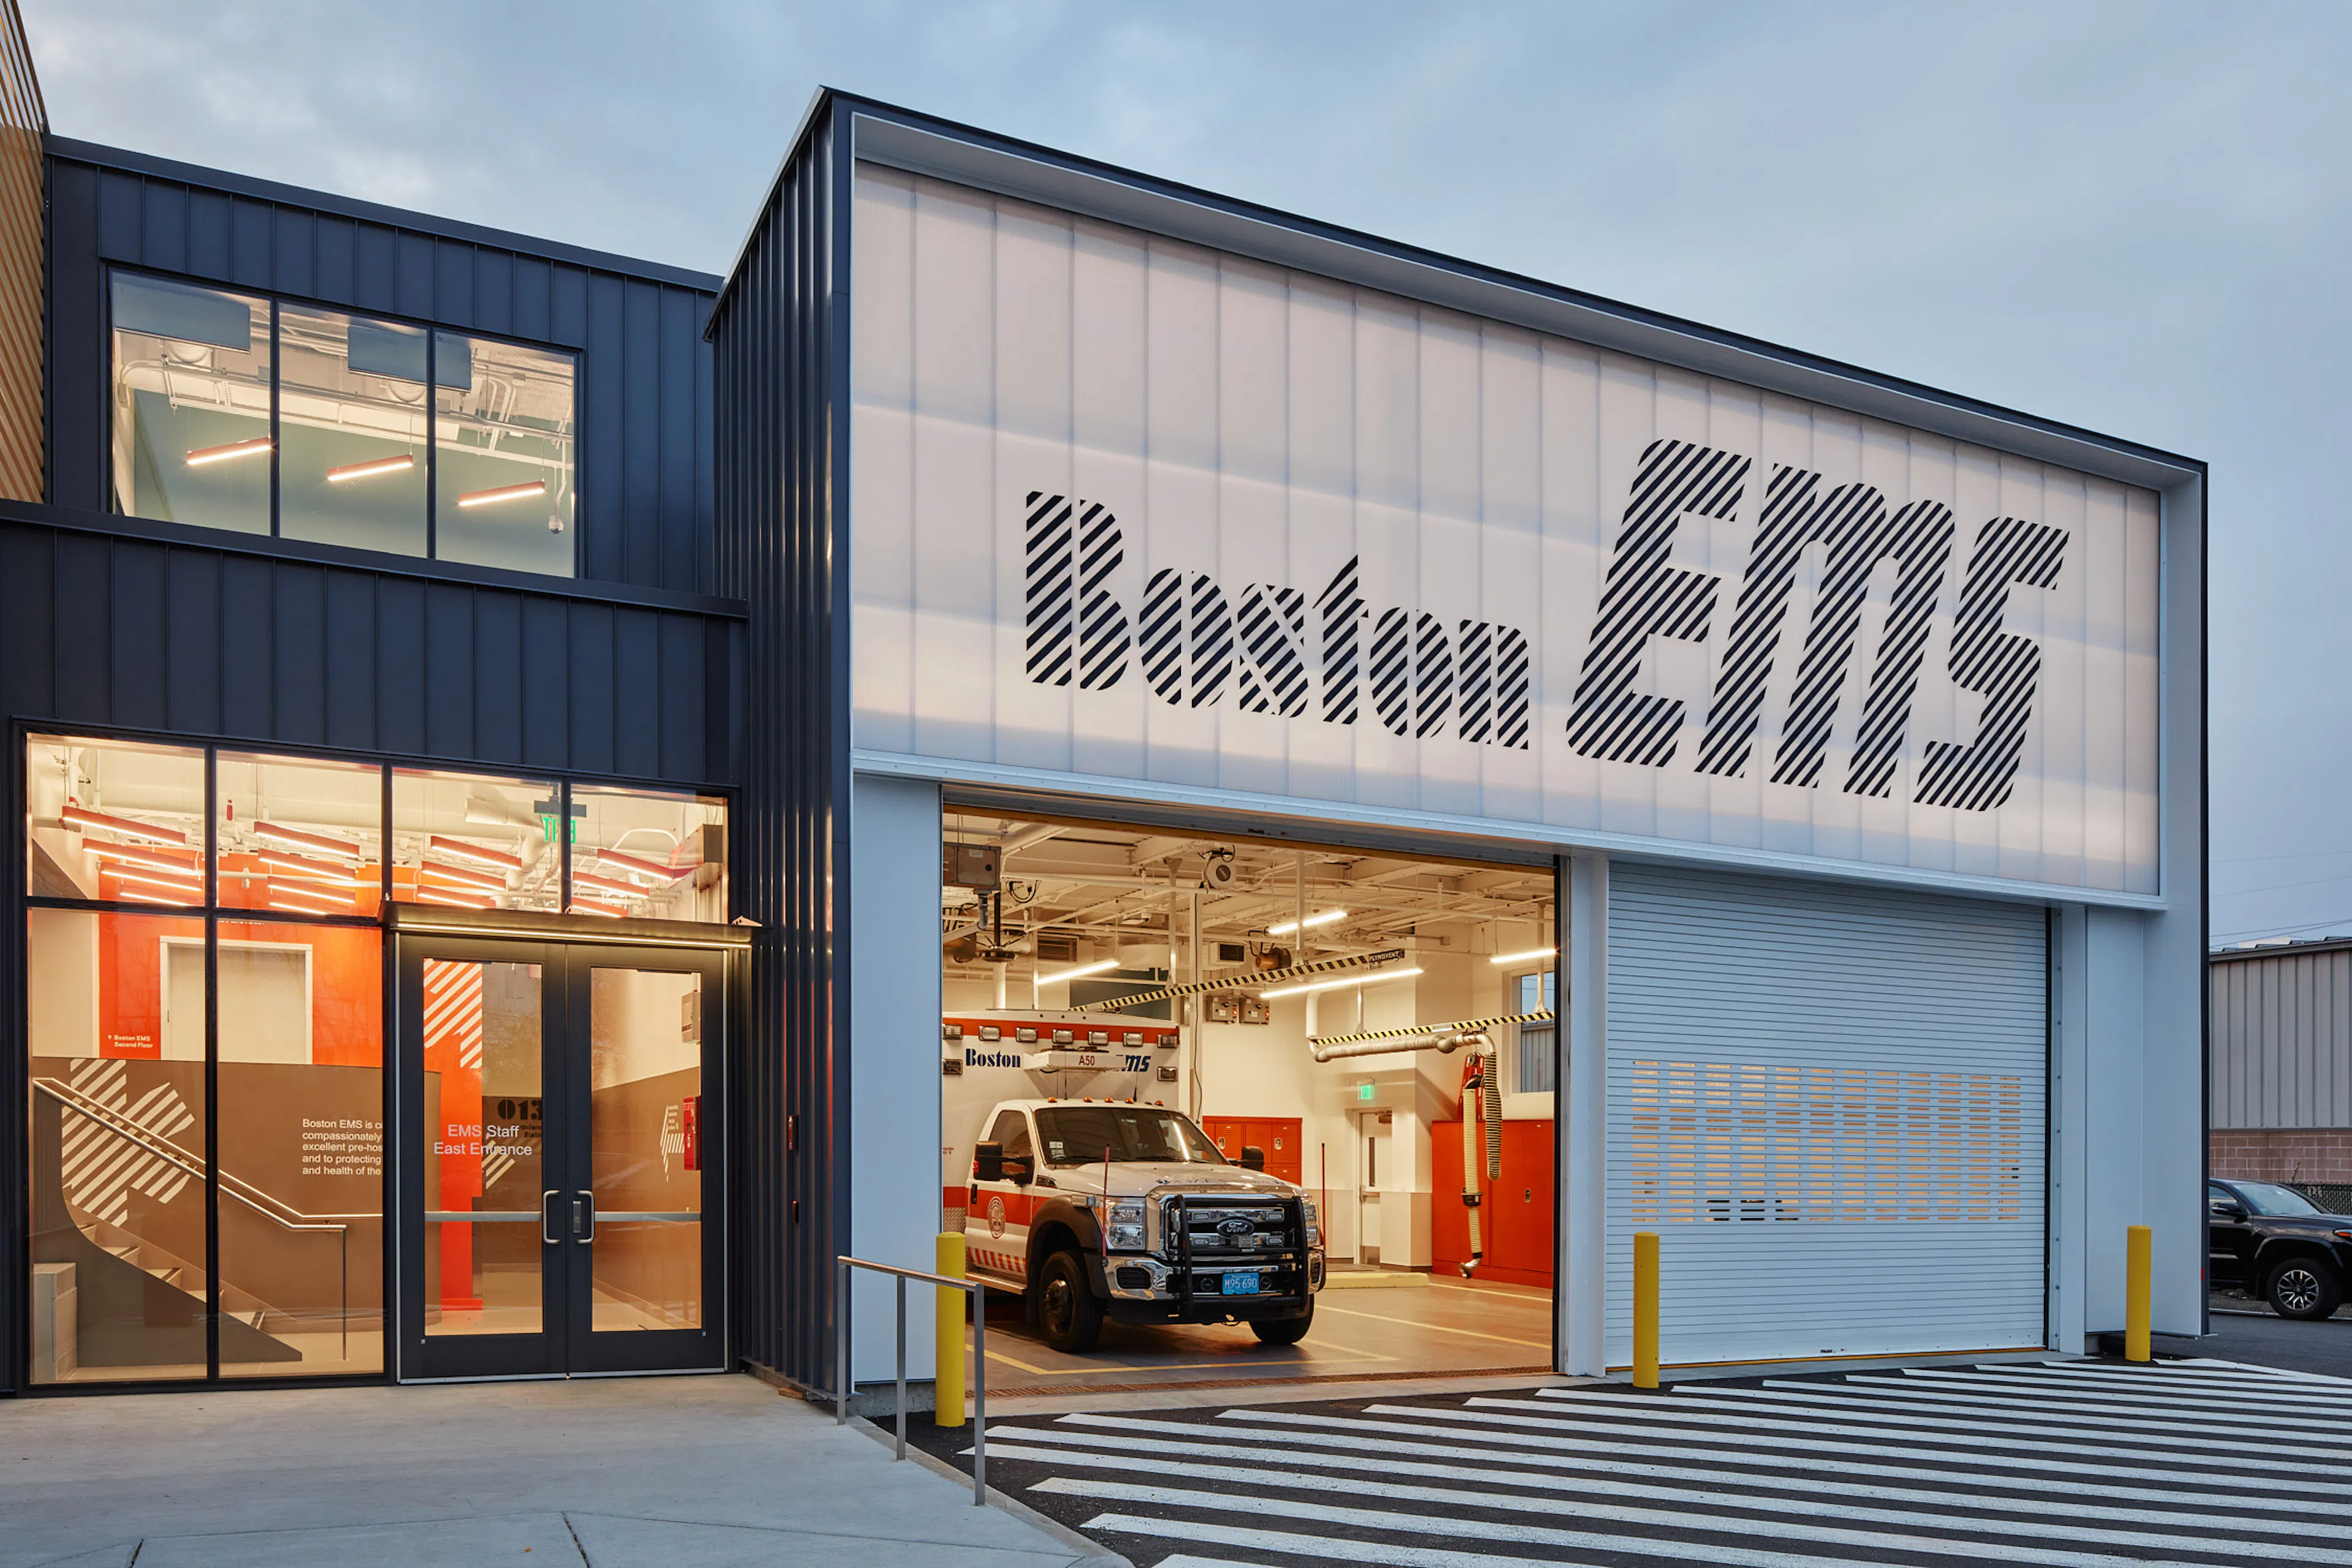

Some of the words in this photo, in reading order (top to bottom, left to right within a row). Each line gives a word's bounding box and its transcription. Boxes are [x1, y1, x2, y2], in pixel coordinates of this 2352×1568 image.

[1027, 491, 1529, 750] Boston
[966, 1049, 1020, 1068] Boston
[1113, 1054, 1151, 1072] MS
[1079, 1055, 1095, 1066] A50
[303, 1118, 336, 1128] Boston
[339, 1120, 363, 1129] EMS
[365, 1120, 373, 1129] is
[448, 1125, 481, 1137] EMS
[487, 1125, 519, 1137] Staff
[303, 1132, 382, 1143] compassionately
[303, 1142, 346, 1151] excellent
[348, 1144, 383, 1153] pre-hos
[434, 1142, 466, 1155] East
[470, 1142, 532, 1155] Entrance
[303, 1154, 321, 1163] and
[323, 1155, 333, 1163] to
[336, 1155, 381, 1165] protecting
[303, 1166, 321, 1175] and
[323, 1166, 353, 1175] health
[367, 1167, 381, 1175] the
[1226, 1222, 1248, 1232] Ford
